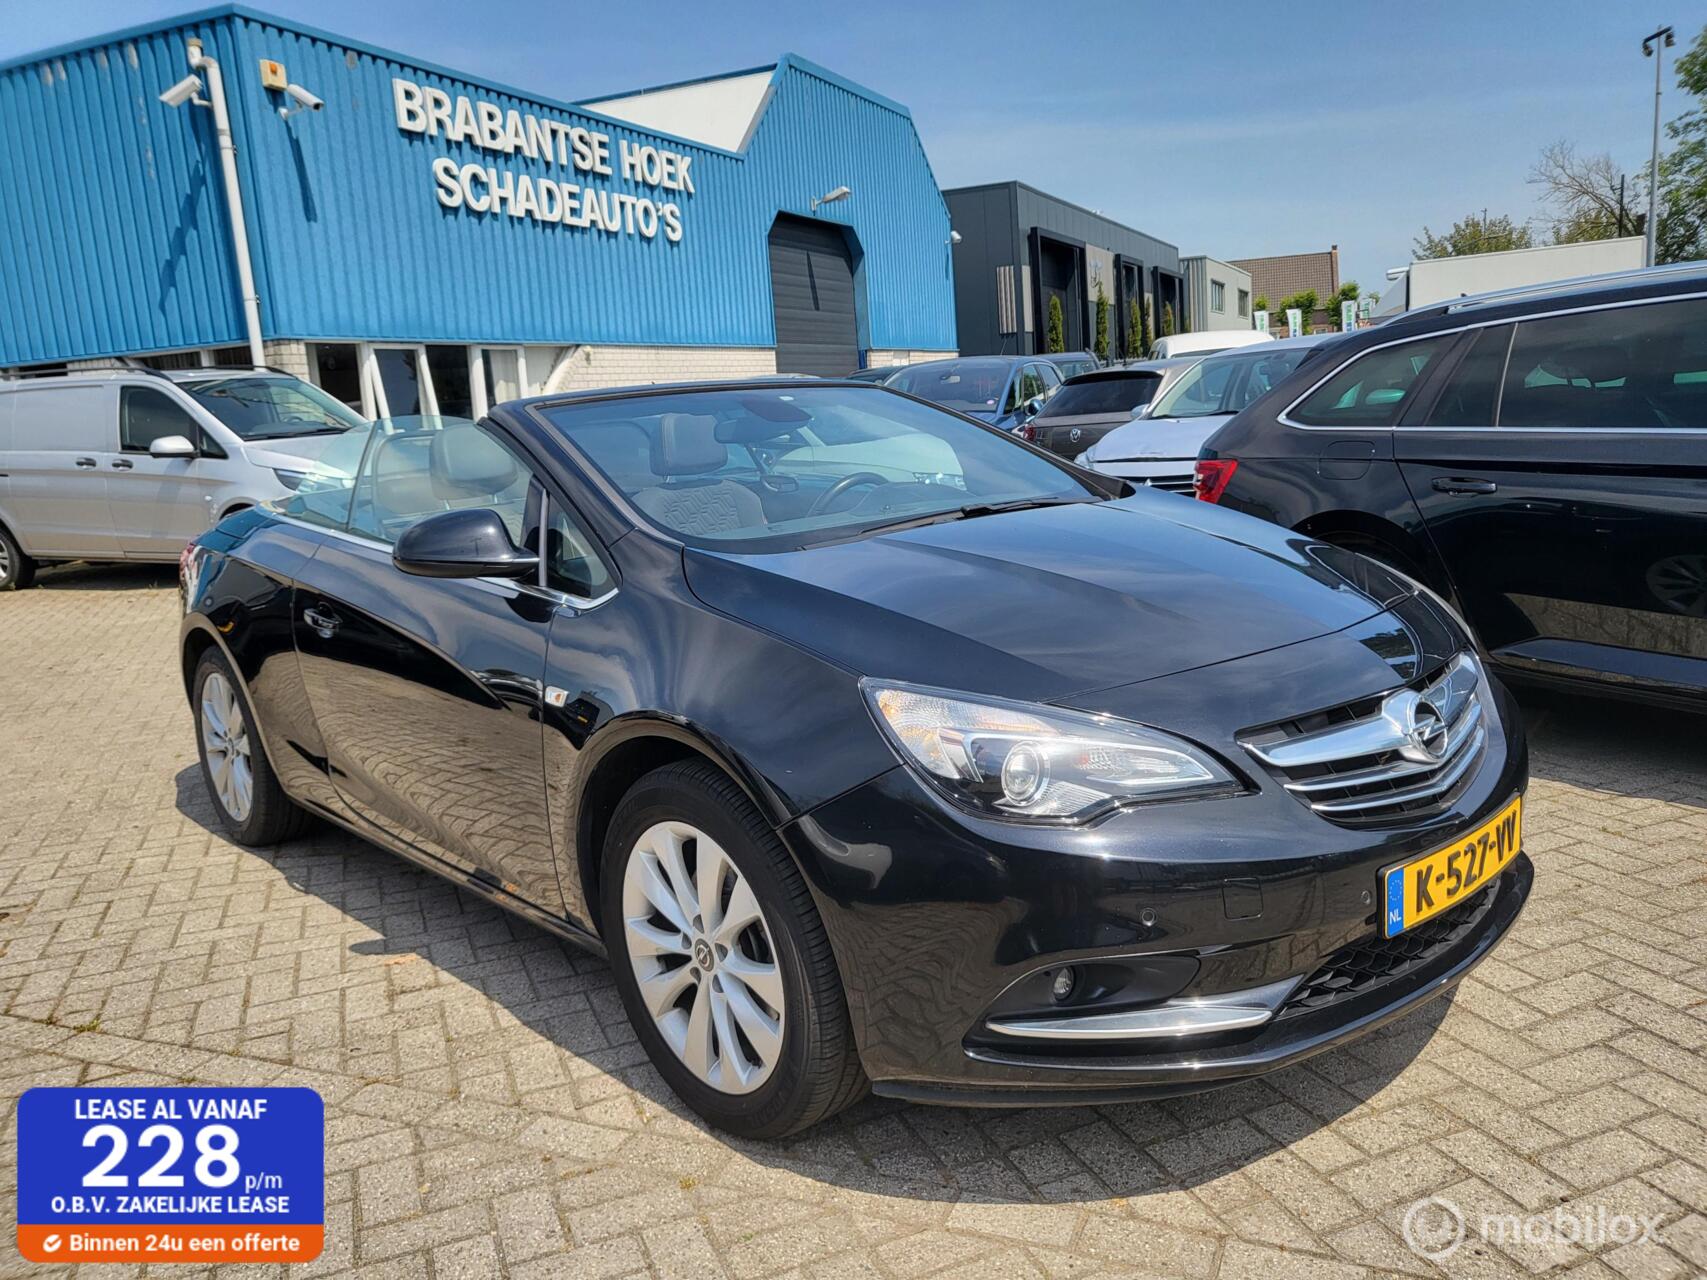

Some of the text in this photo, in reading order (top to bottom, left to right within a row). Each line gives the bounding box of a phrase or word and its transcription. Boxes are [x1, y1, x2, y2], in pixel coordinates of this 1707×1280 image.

[391, 78, 696, 194] BRABANTSE HOEK
[432, 157, 683, 242] SCHADEAUTO'S
[1415, 809, 1517, 914] K-527-VV
[1389, 908, 1402, 925] NL
